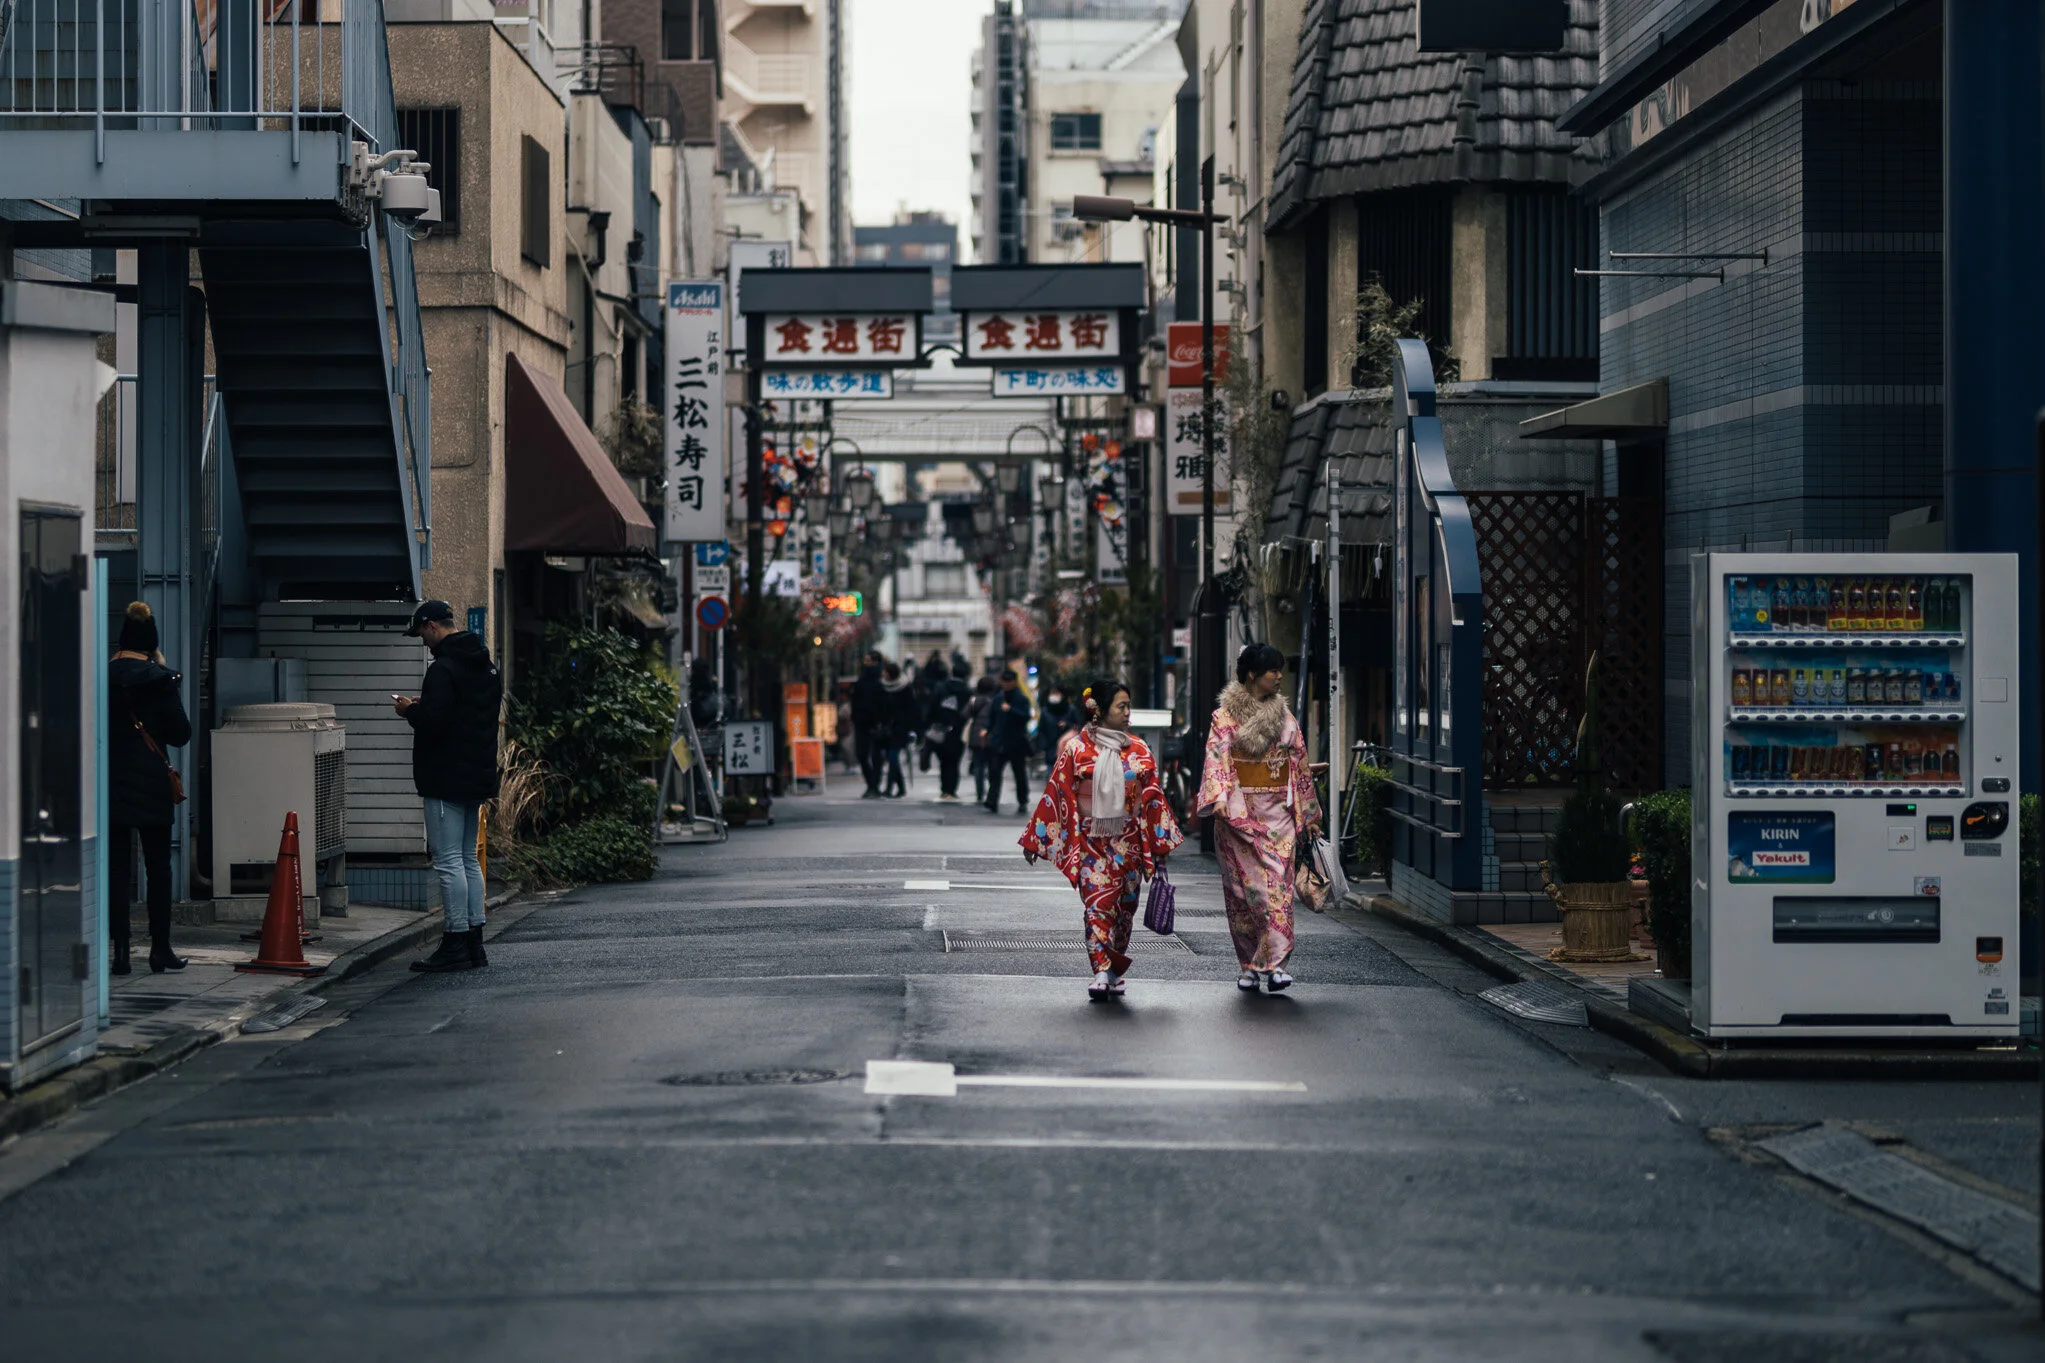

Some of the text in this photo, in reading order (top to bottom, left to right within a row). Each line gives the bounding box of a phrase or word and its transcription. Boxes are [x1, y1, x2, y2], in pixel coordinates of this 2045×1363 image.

[675, 290, 716, 305] Asahi
[774, 317, 906, 354] 食通街
[978, 313, 1109, 351] 食通街
[707, 331, 719, 375] 江戸前
[767, 371, 884, 393] 味の散歩道
[1001, 368, 1119, 389] 下町の味処
[673, 357, 708, 511] 三松寿司
[732, 732, 749, 769] 三松
[1761, 828, 1799, 840] KIRIN
[1756, 854, 1806, 863] Yakult
